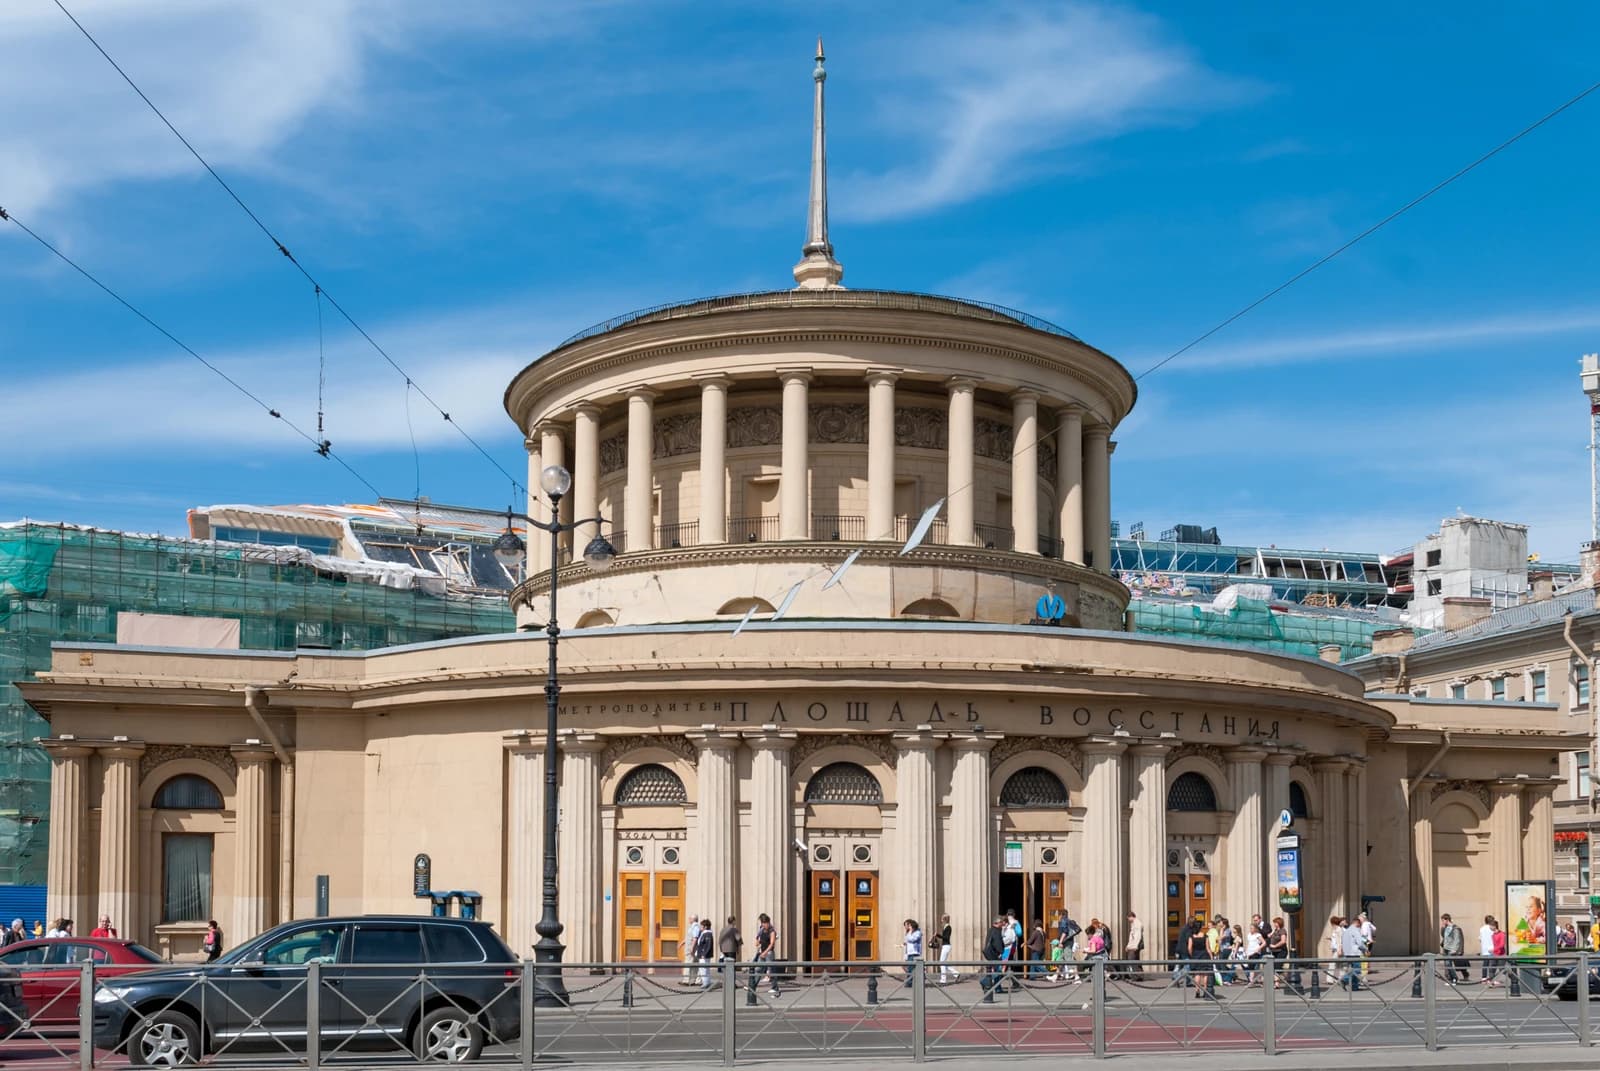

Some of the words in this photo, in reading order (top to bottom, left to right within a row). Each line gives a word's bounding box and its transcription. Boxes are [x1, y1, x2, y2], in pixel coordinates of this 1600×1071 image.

[558, 702, 722, 716] МЕТРОПОЛИТЕН
[729, 701, 980, 724] ПЛОЩАДЬ
[1039, 705, 1280, 740] ВОССТАНИЯ
